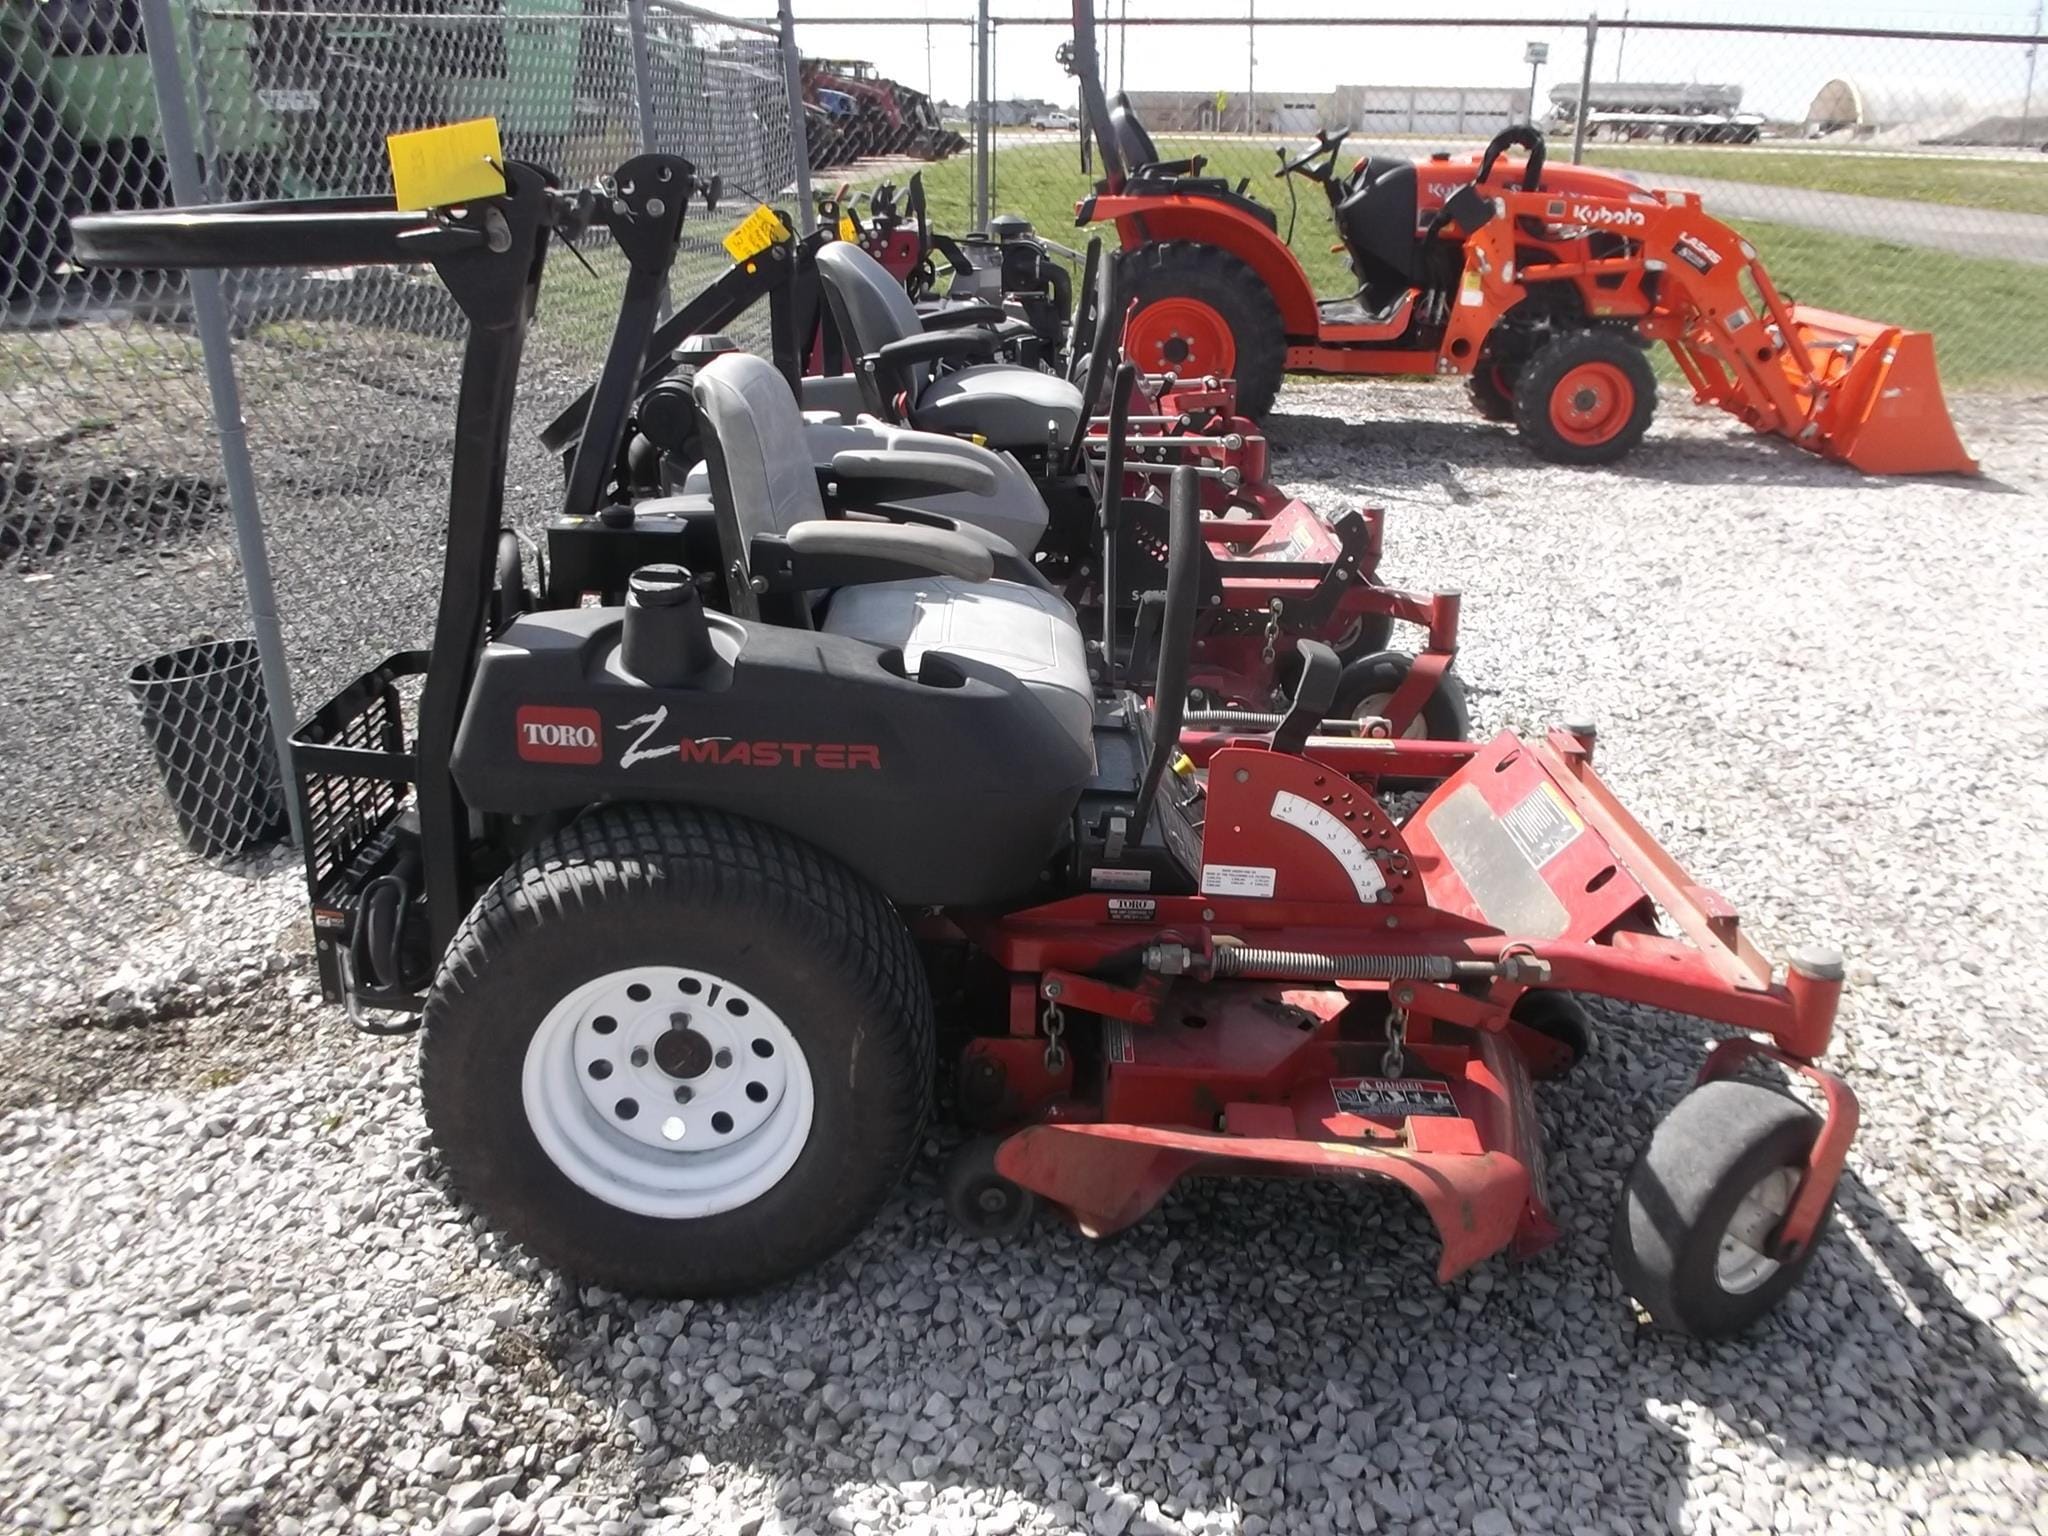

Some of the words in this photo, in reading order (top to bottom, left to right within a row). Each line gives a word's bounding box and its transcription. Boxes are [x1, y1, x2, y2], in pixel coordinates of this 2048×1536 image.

[1573, 204, 1645, 226] Kubota
[523, 722, 598, 748] TORO
[680, 738, 881, 769] MASTER
[1117, 899, 1147, 909] TORO
[1375, 1081, 1424, 1091] DANGER
